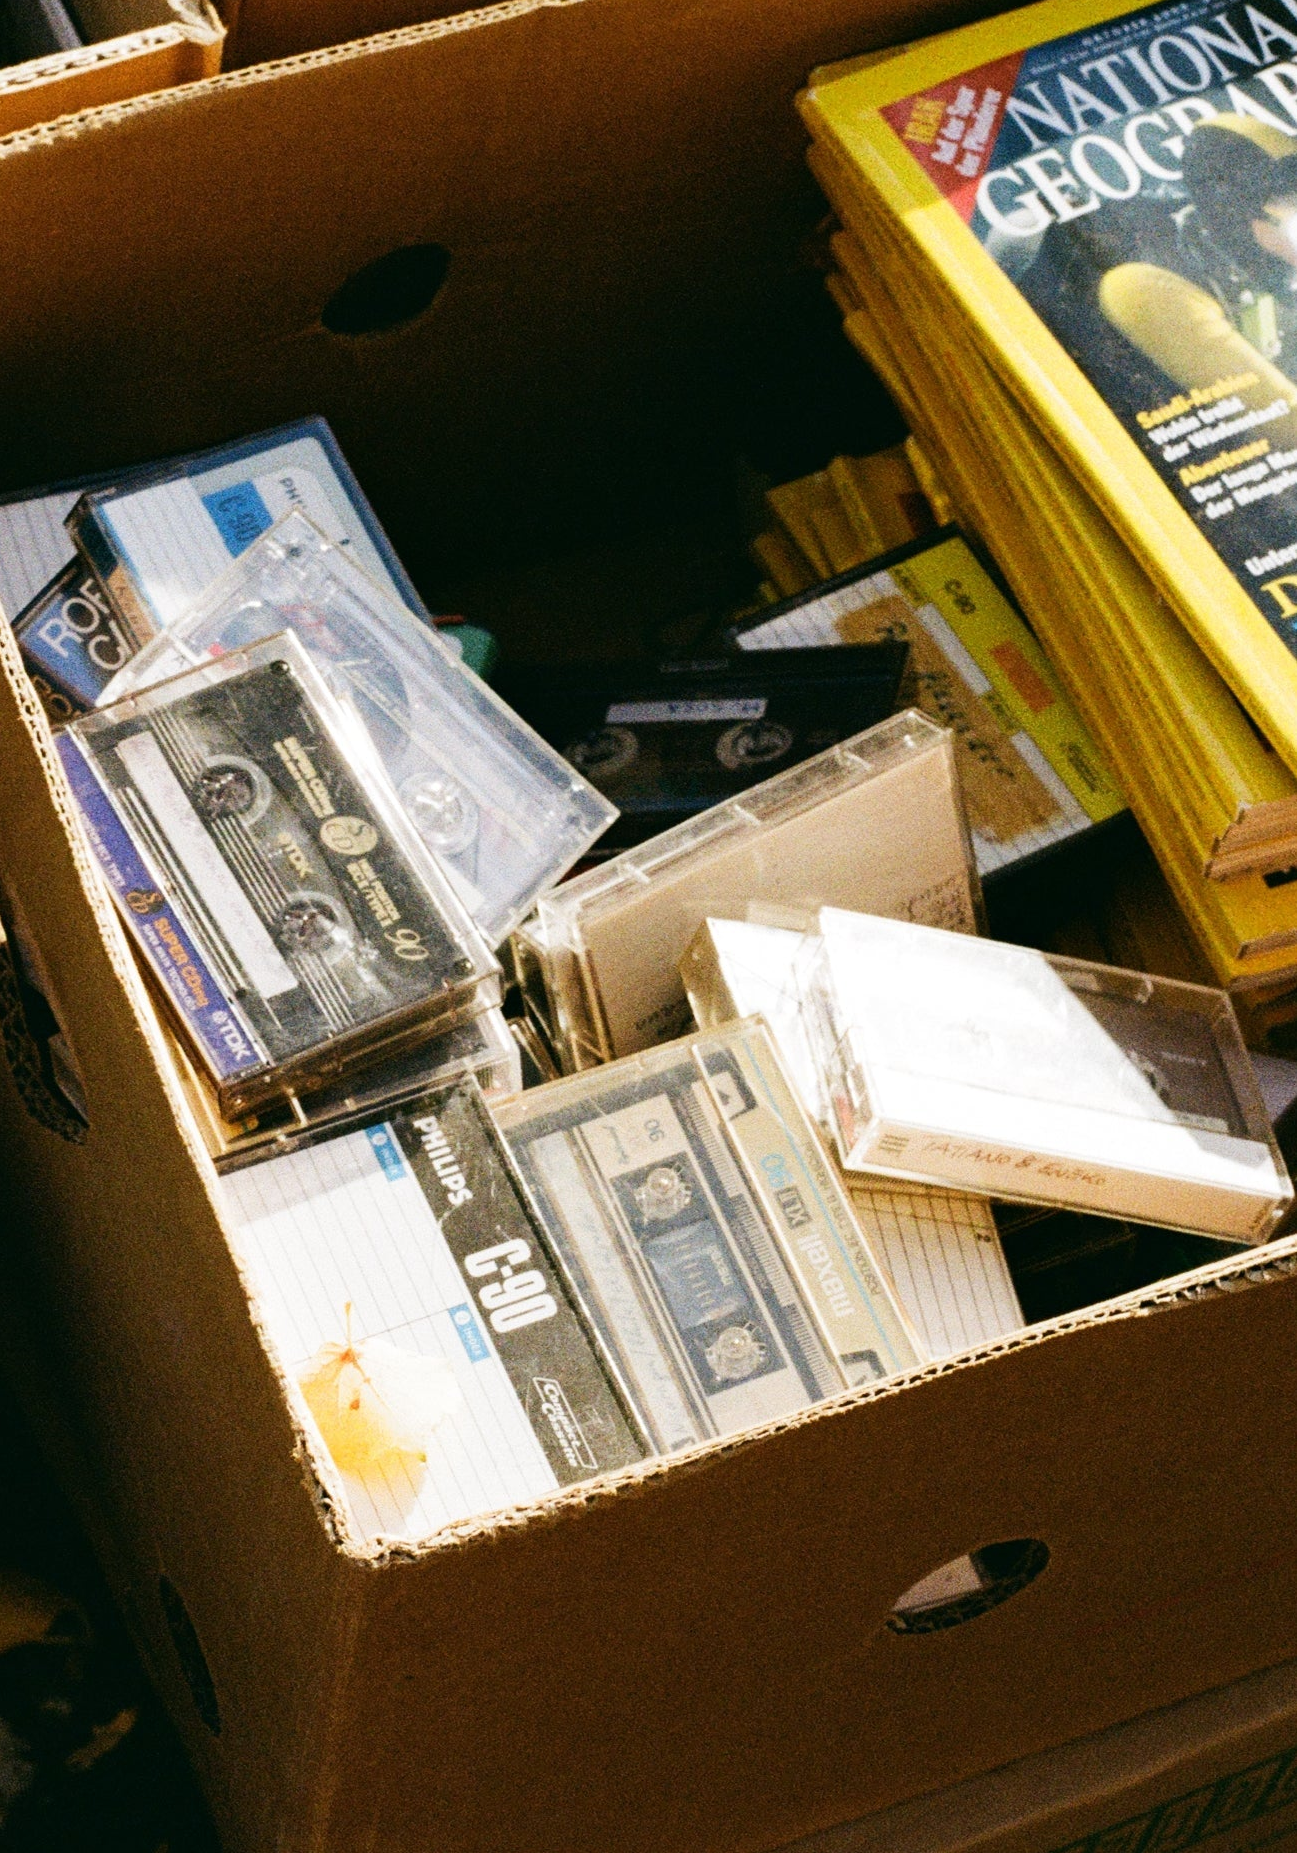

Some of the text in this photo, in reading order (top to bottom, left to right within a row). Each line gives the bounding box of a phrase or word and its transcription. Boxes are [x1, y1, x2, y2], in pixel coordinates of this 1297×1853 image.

[1006, 0, 1297, 149] NATIONA
[281, 838, 314, 879] TDK
[370, 879, 401, 922] POSITION
[151, 915, 214, 1009] SUPER CDing
[383, 918, 430, 970] 90
[217, 1018, 251, 1062] TDK
[412, 1115, 473, 1207] PHILIPS
[642, 1116, 666, 1143] 90
[757, 1149, 795, 1192] 90
[464, 1238, 558, 1333] C-90
[795, 1229, 856, 1322] maxell
[539, 1400, 579, 1470] Cassette
[541, 1380, 582, 1450] Compact
